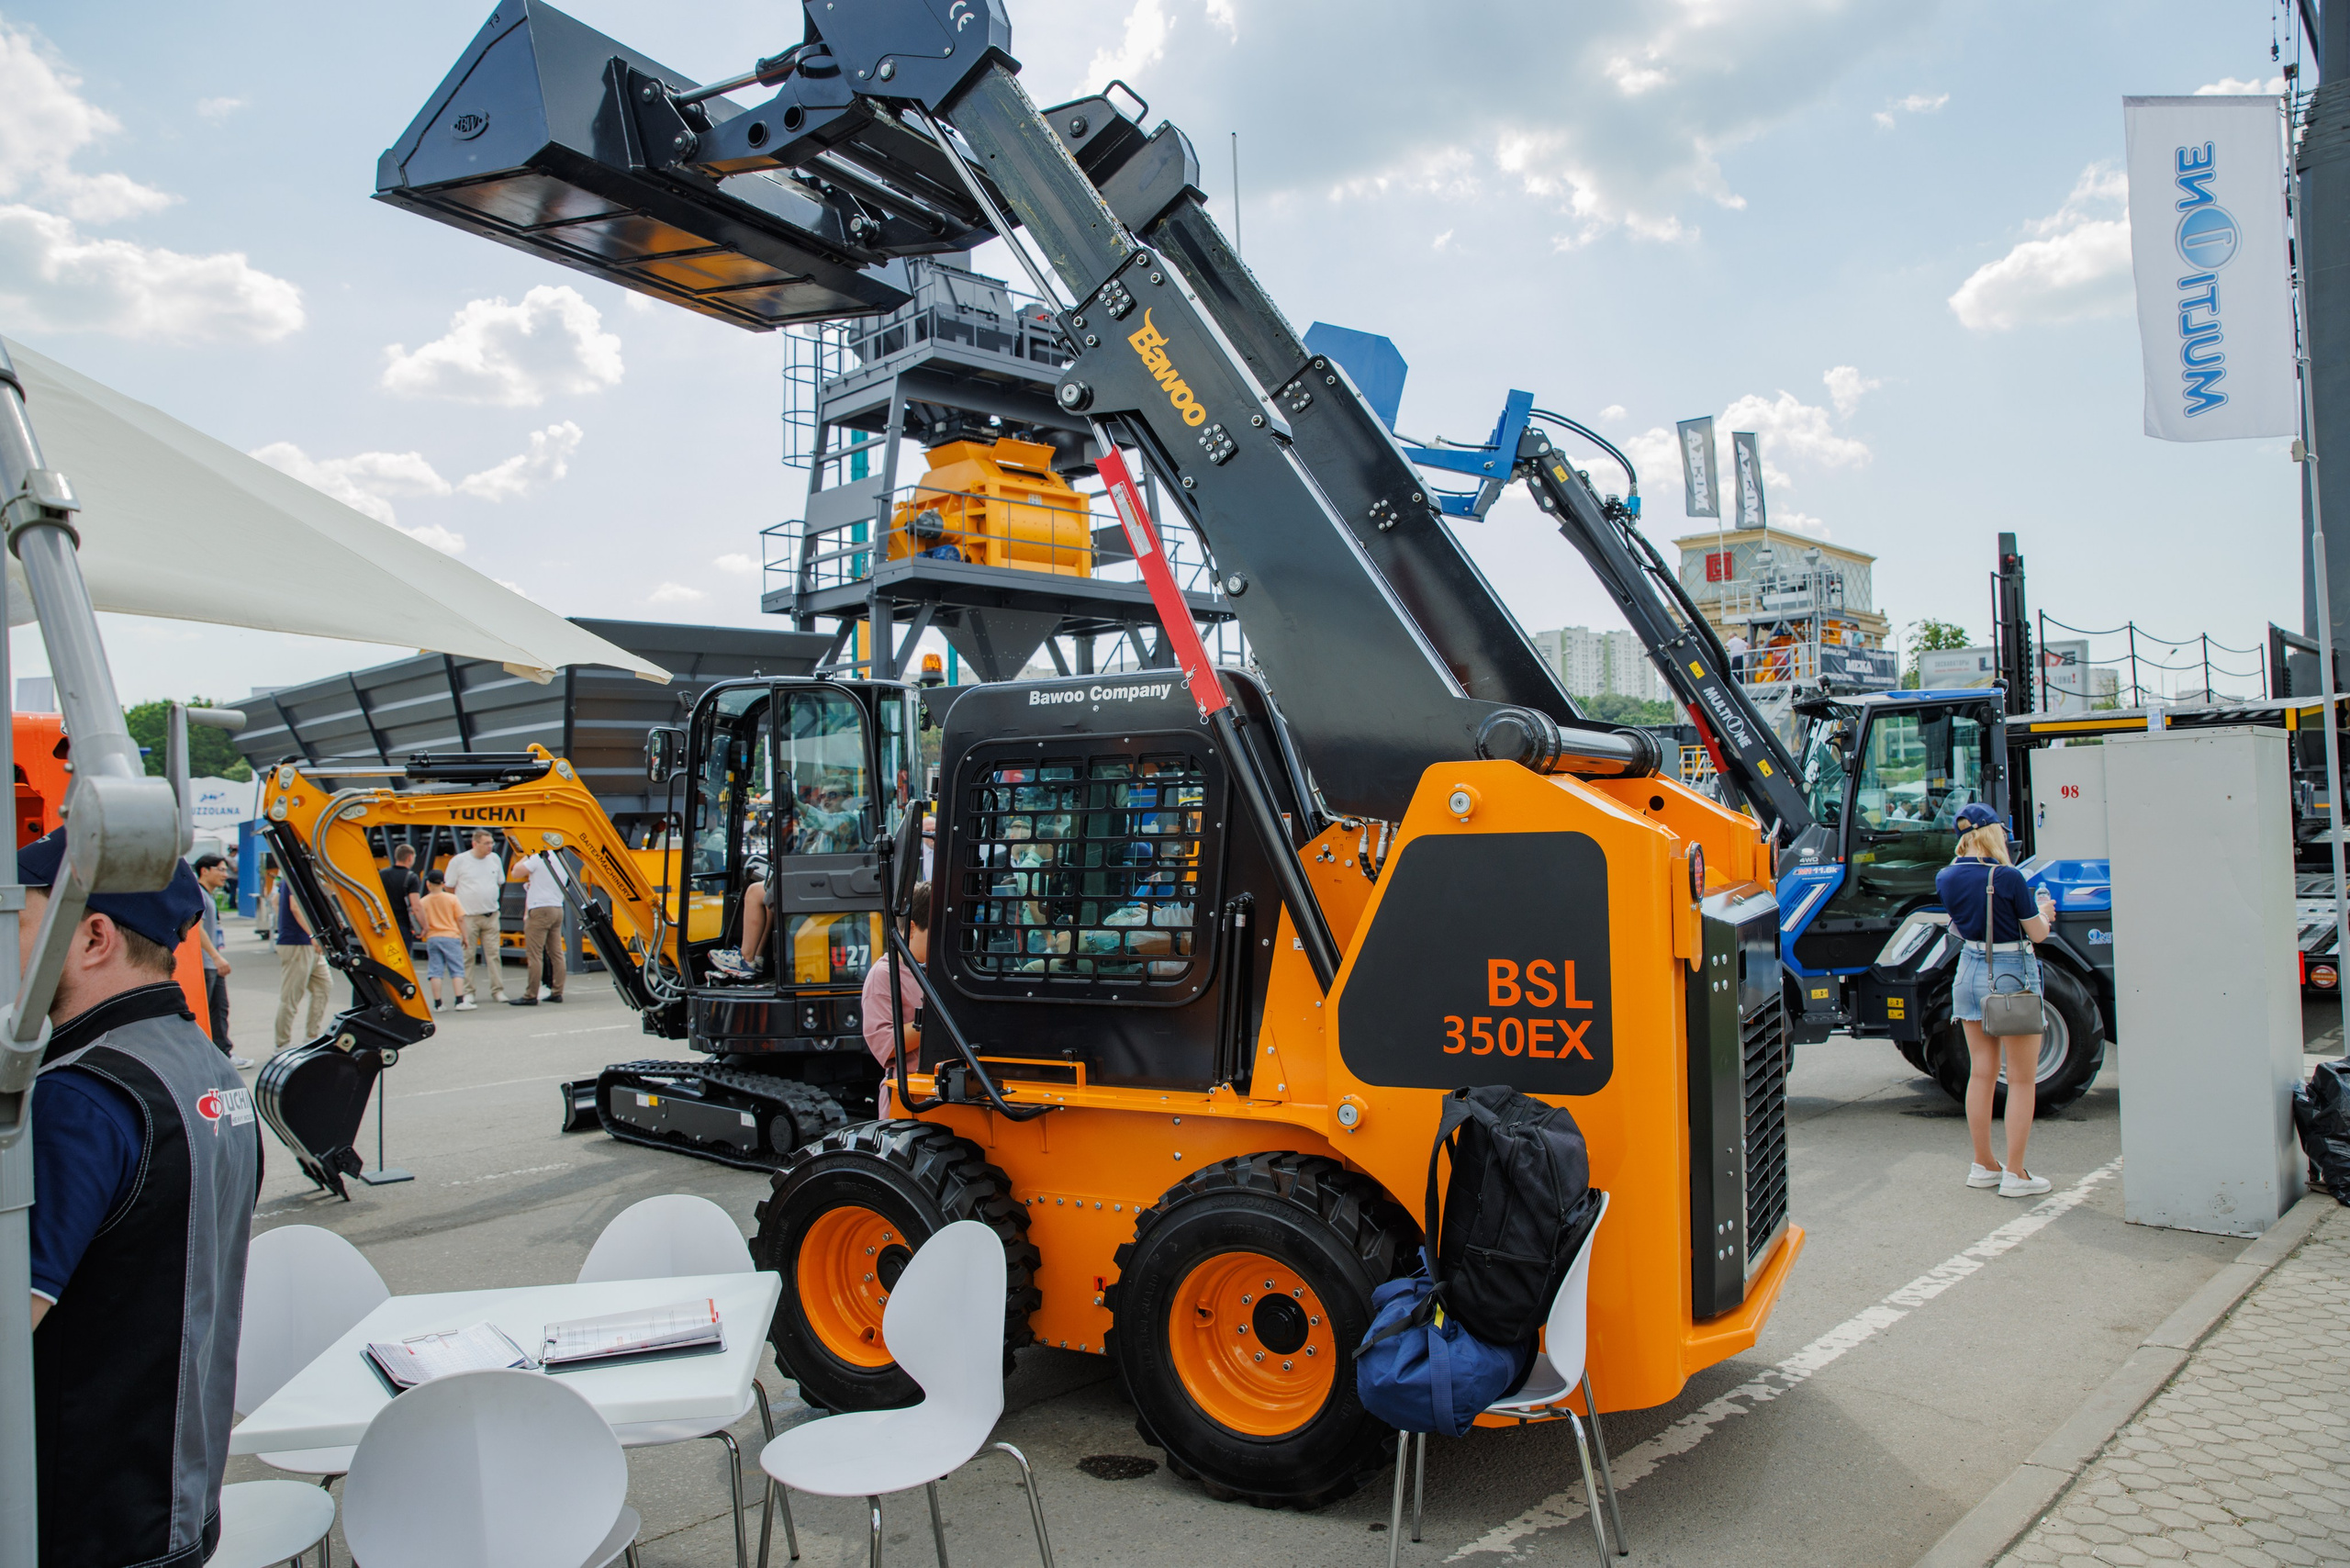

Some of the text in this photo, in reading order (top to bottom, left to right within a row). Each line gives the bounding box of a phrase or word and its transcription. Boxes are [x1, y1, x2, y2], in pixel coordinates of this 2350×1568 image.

[1029, 684, 1172, 706] Bawoo Company
[2061, 784, 2079, 799] 98
[449, 807, 526, 823] YUCHAI
[1488, 958, 1594, 1009] BSL
[1442, 1015, 1595, 1060] 350EX
[1238, 1196, 1281, 1212] POWER
